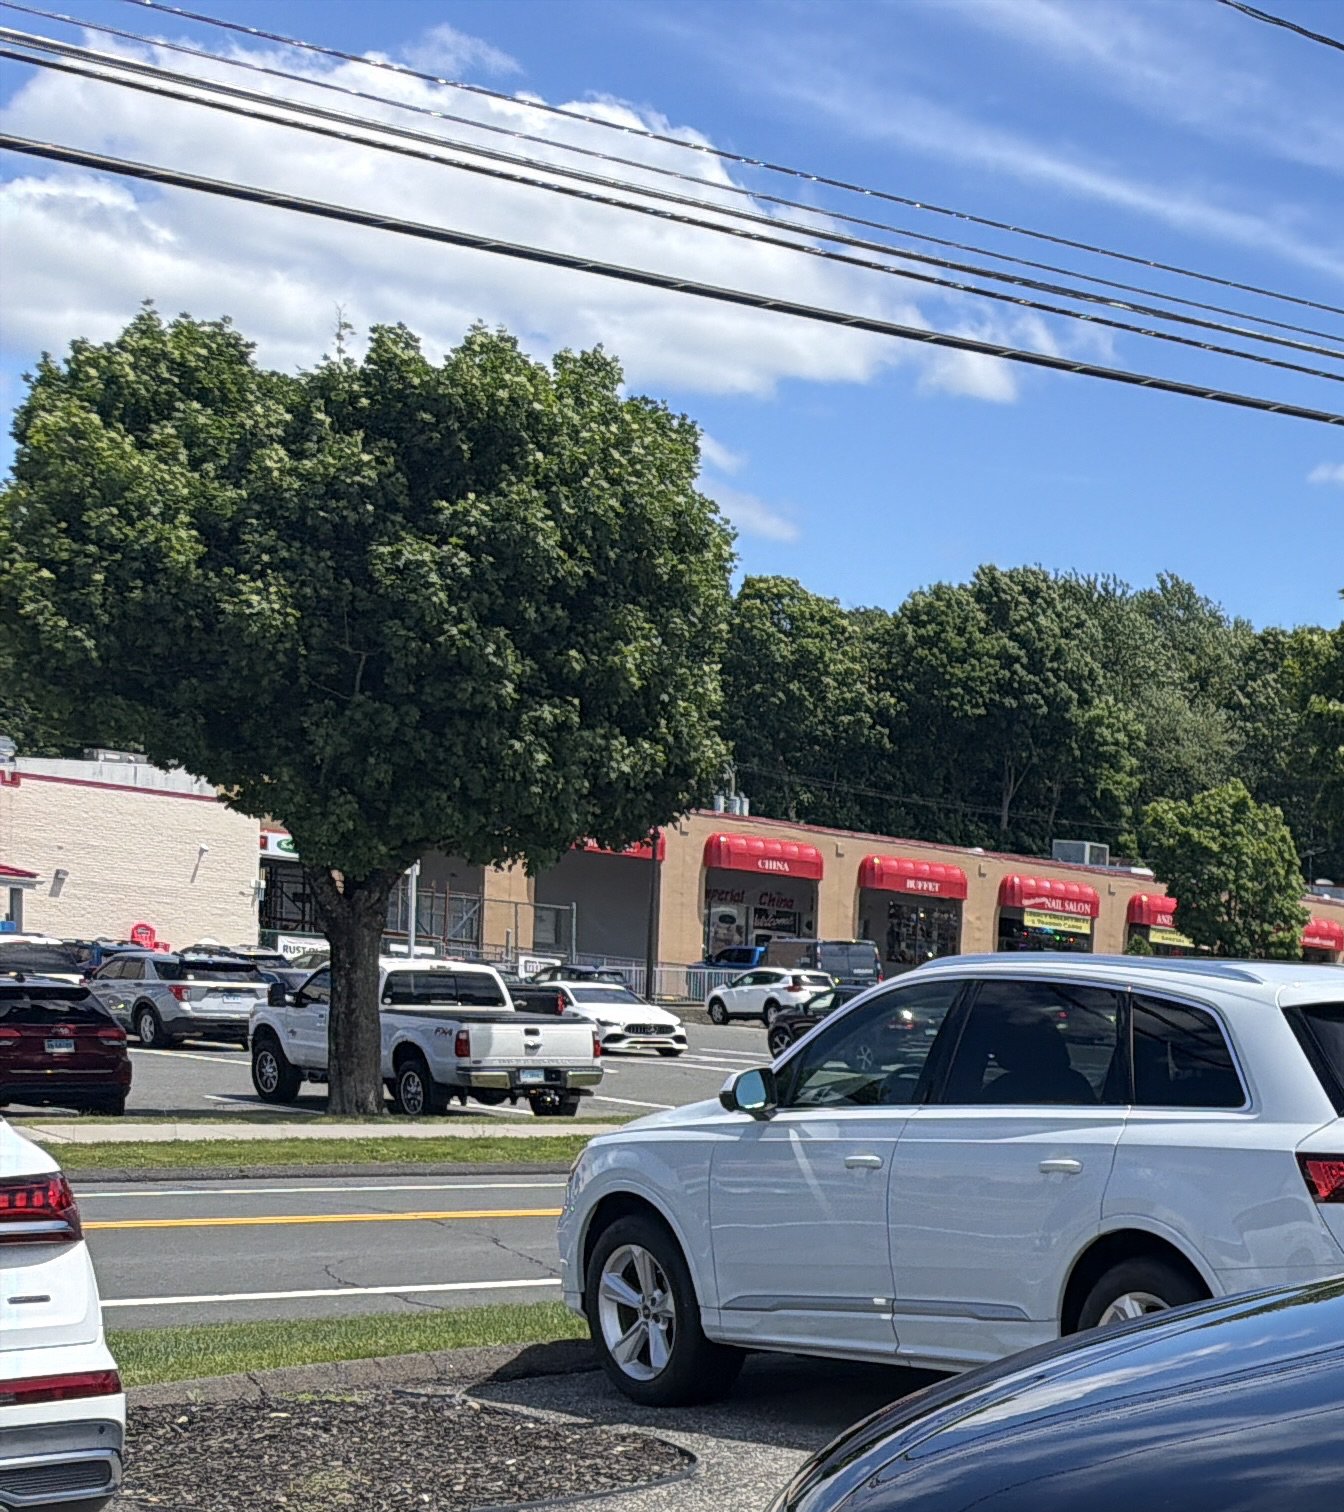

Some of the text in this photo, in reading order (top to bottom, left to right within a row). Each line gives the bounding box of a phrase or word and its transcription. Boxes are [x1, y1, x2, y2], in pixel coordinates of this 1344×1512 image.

[757, 859, 790, 872] CHINA
[906, 879, 940, 892] BUFFET
[1044, 898, 1091, 914] NAIL SALON
